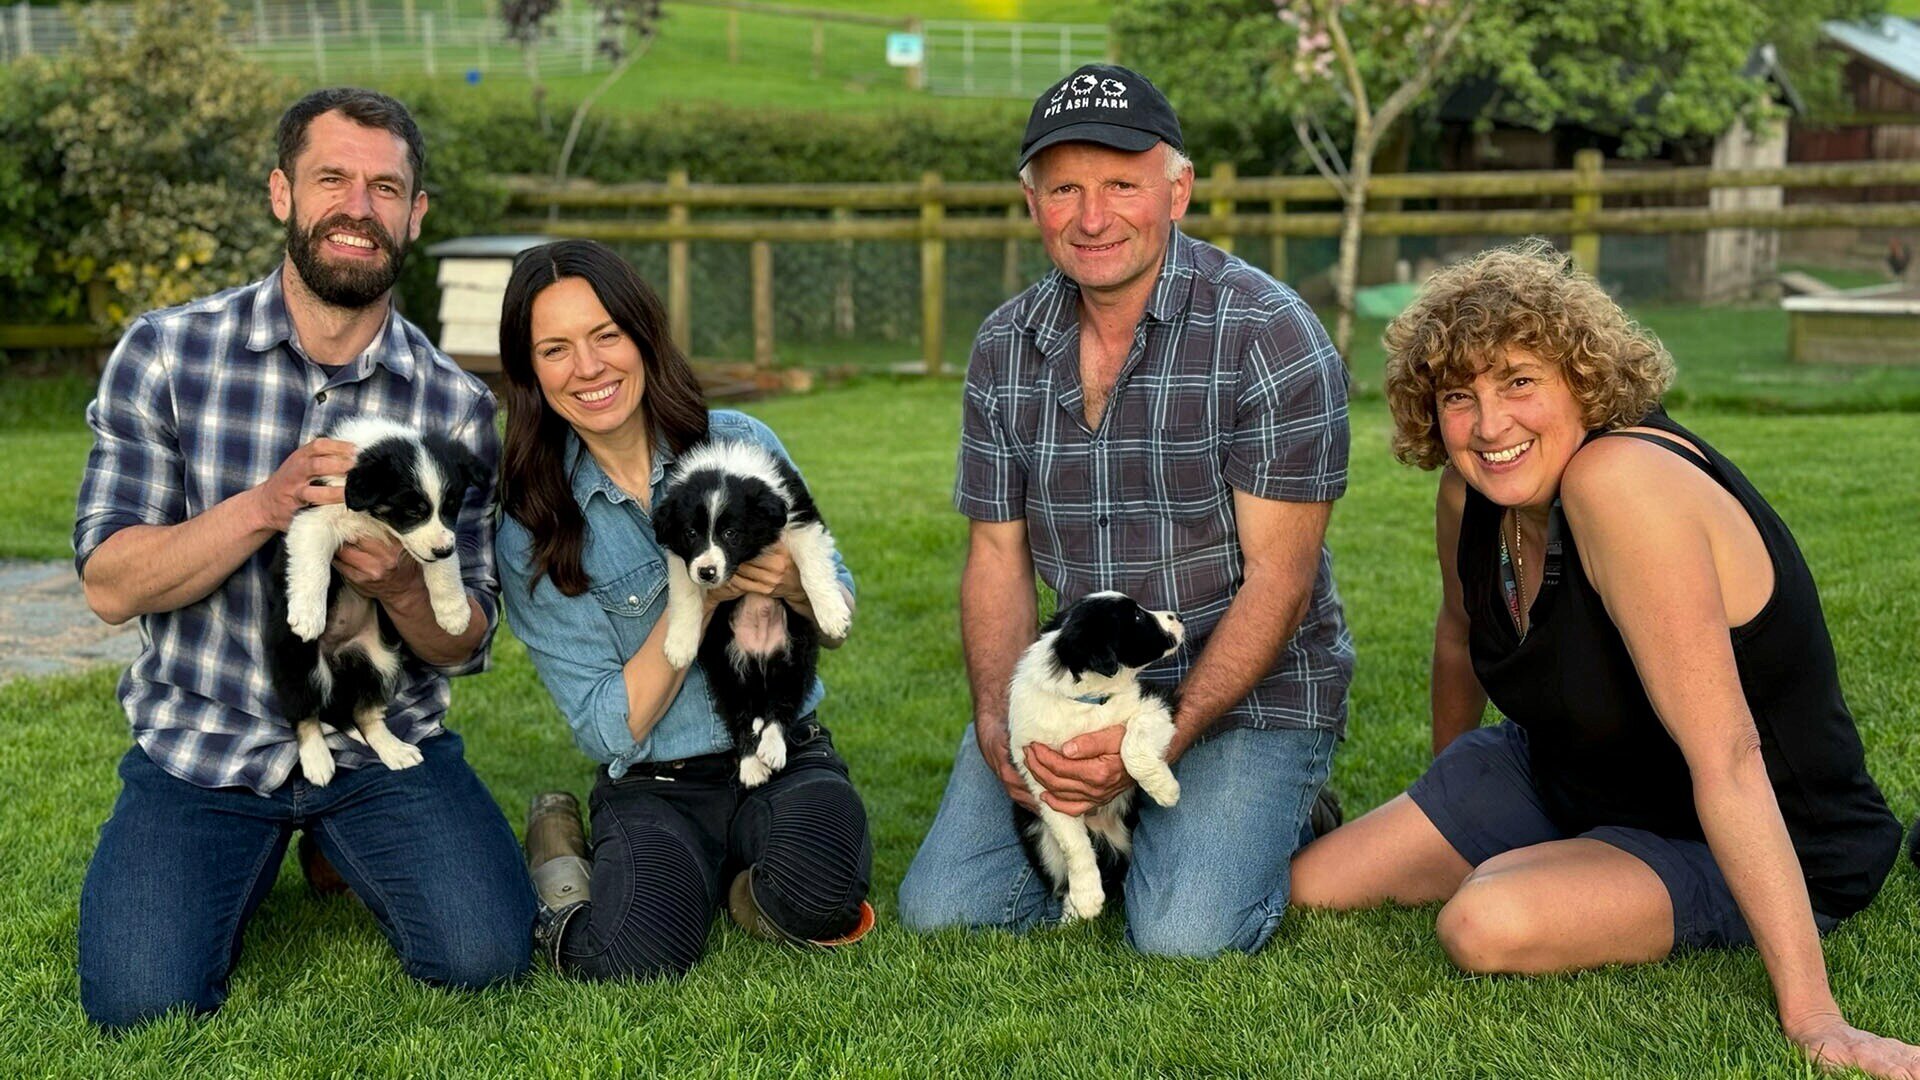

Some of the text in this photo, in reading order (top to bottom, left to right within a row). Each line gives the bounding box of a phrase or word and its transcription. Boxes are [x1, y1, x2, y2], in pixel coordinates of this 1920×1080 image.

[1044, 97, 1129, 119] PYE ASH FARM
